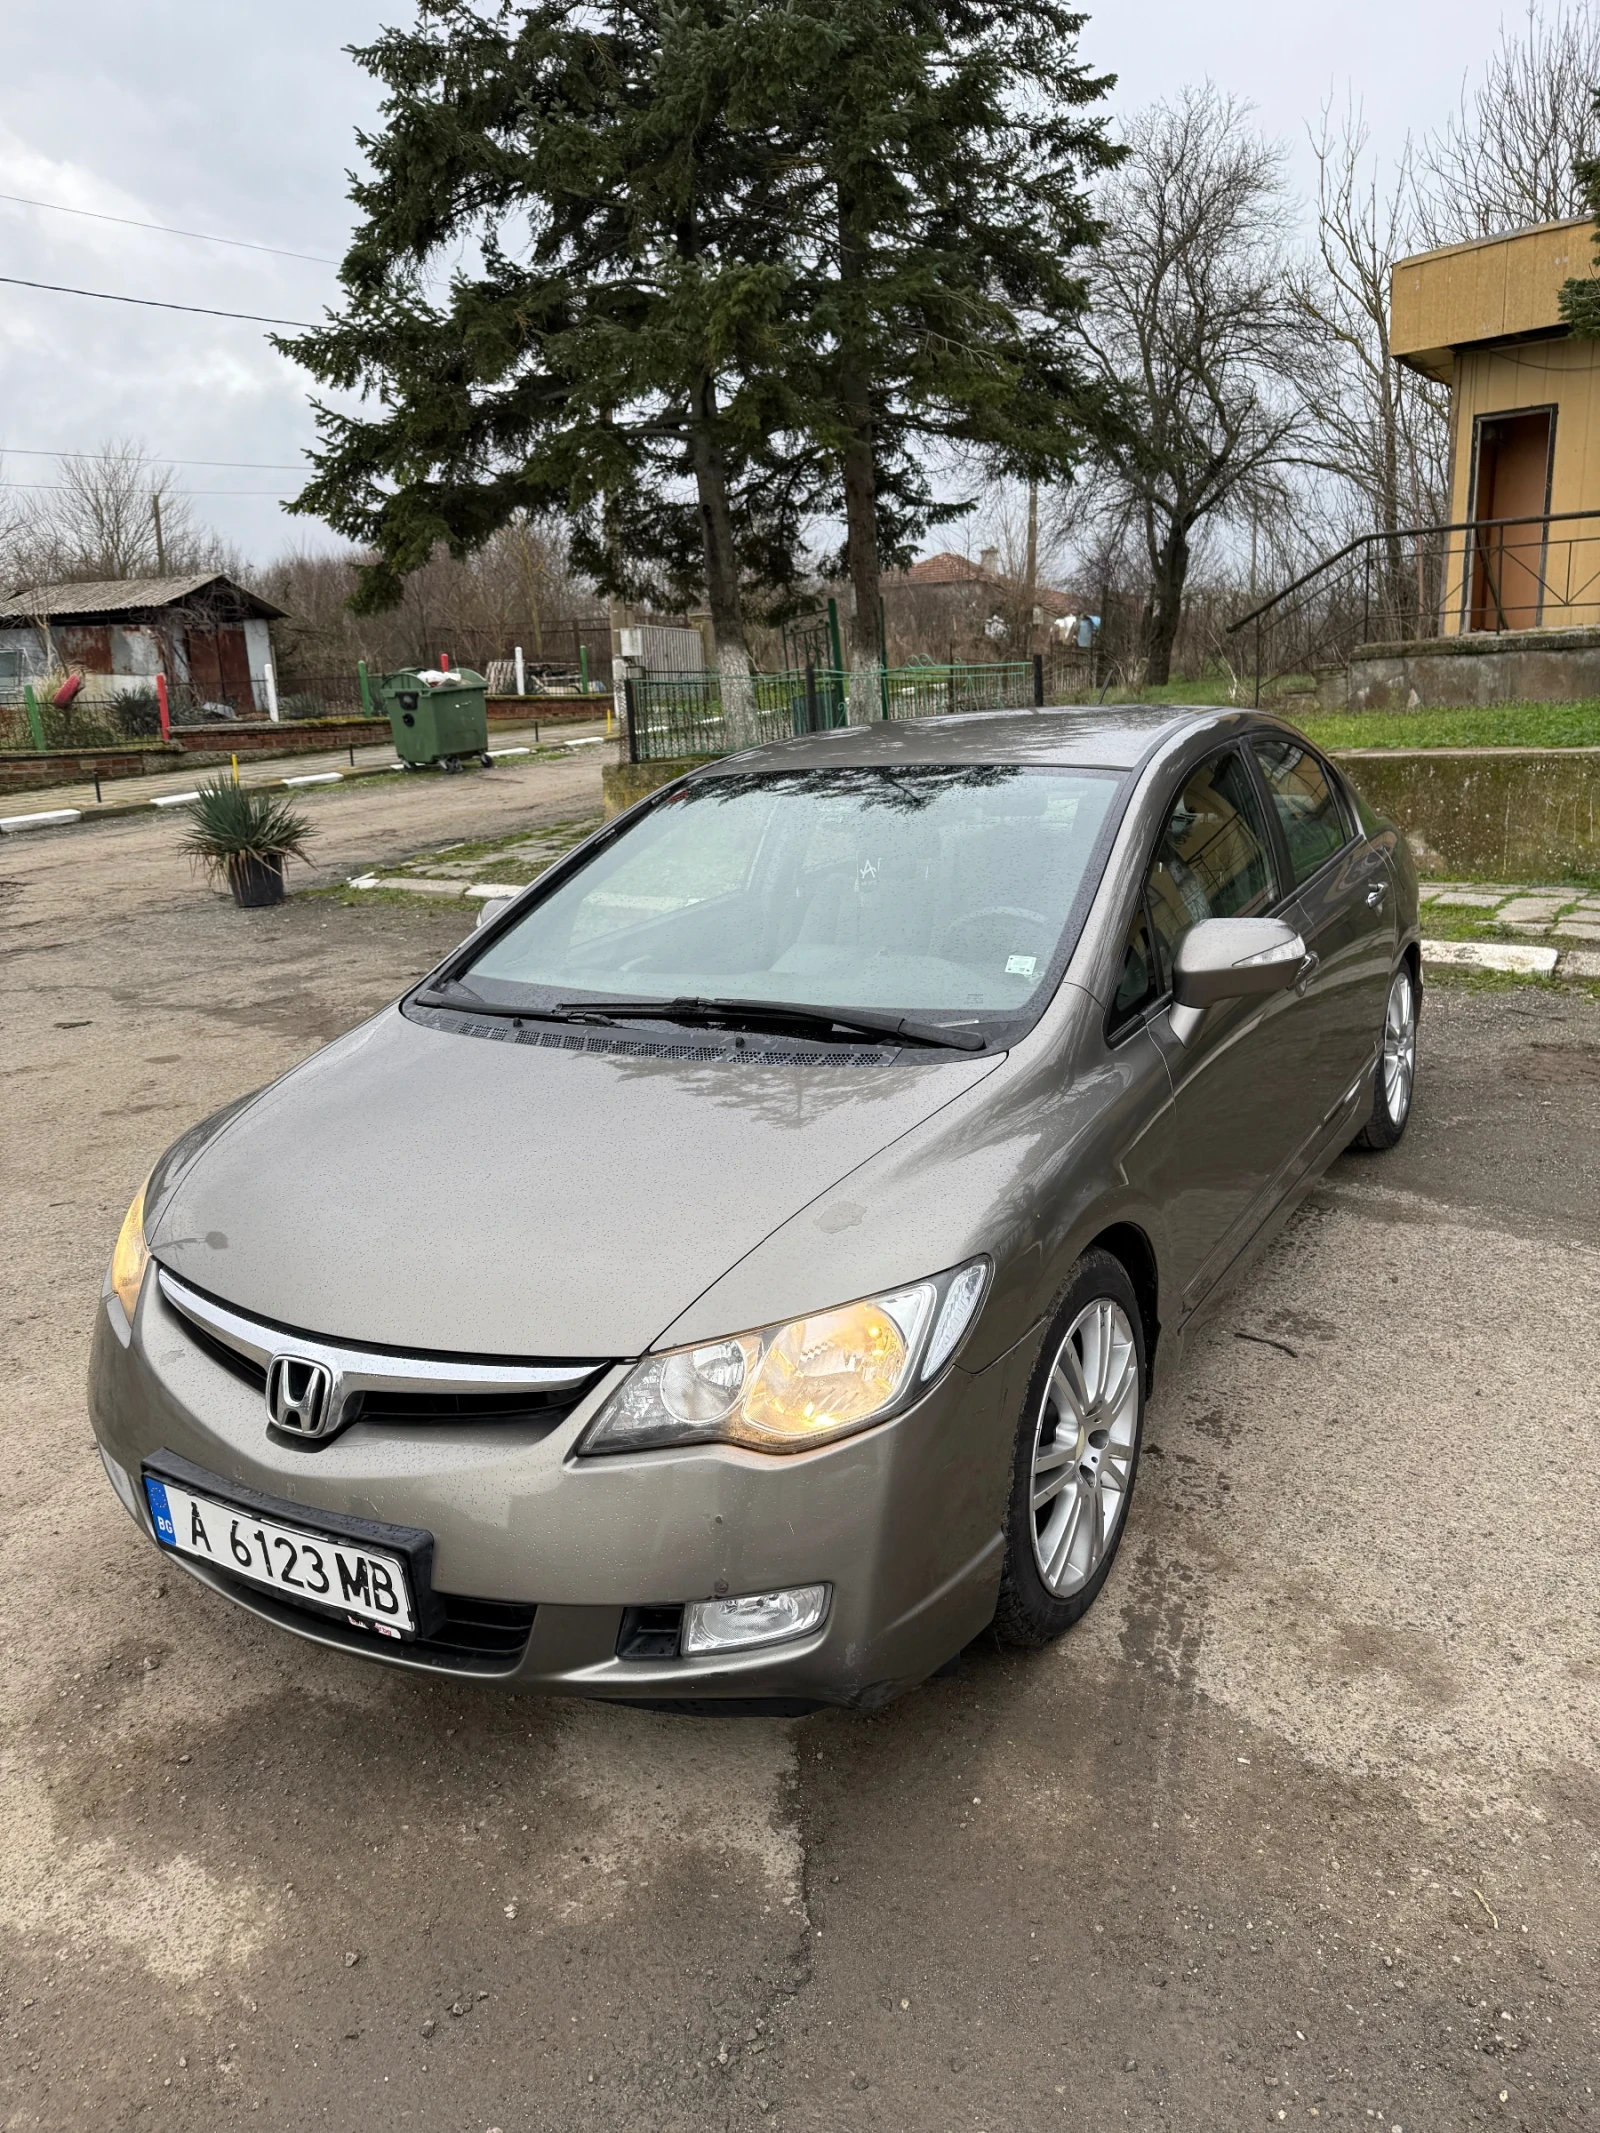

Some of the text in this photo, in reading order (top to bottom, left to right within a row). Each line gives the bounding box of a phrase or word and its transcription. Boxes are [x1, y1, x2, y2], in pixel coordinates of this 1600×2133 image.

[157, 1515, 173, 1534] BG
[191, 1501, 399, 1615] A 6123 MB
